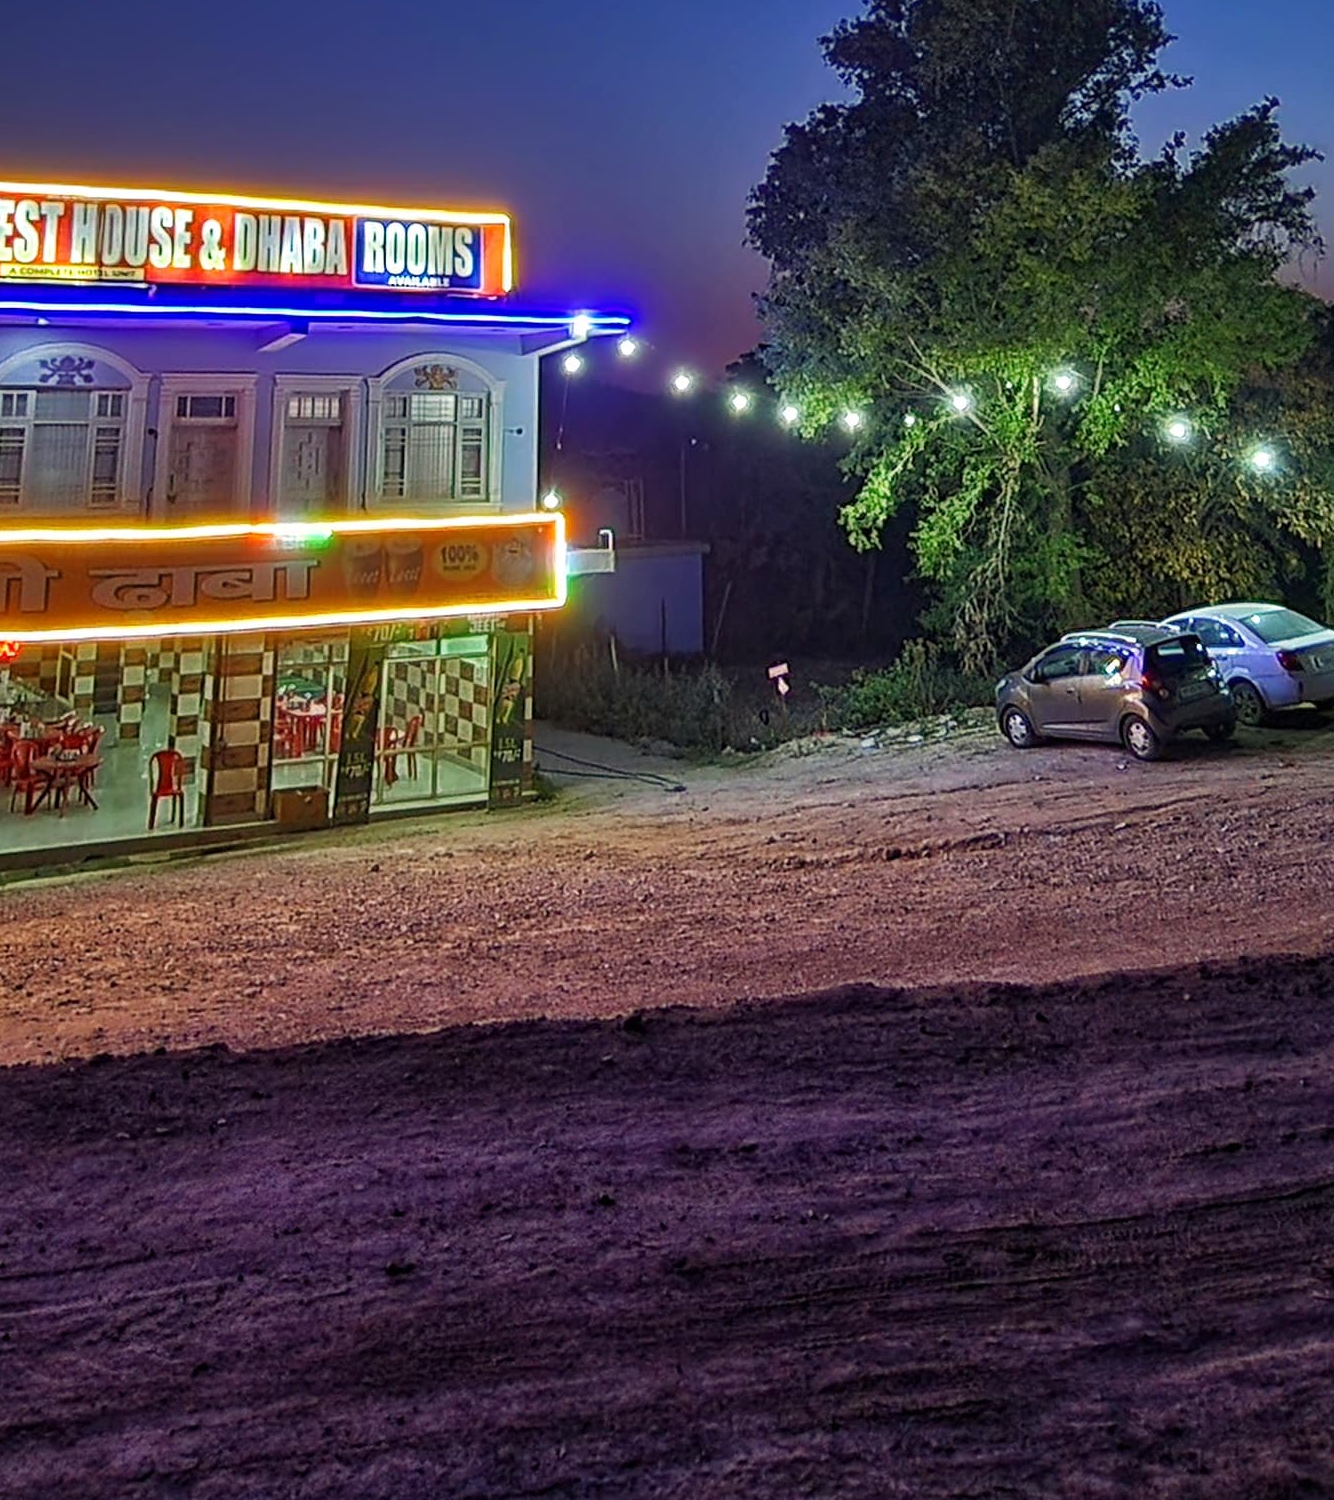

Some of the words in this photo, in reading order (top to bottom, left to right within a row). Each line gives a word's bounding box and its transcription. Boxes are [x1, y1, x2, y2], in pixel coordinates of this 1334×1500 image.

[70, 202, 193, 269] HOUSE
[199, 218, 226, 271] &
[233, 212, 348, 275] DHABA
[363, 221, 474, 277] ROOMS
[388, 275, 451, 287] AVAILABLE
[440, 544, 480, 564] 100%
